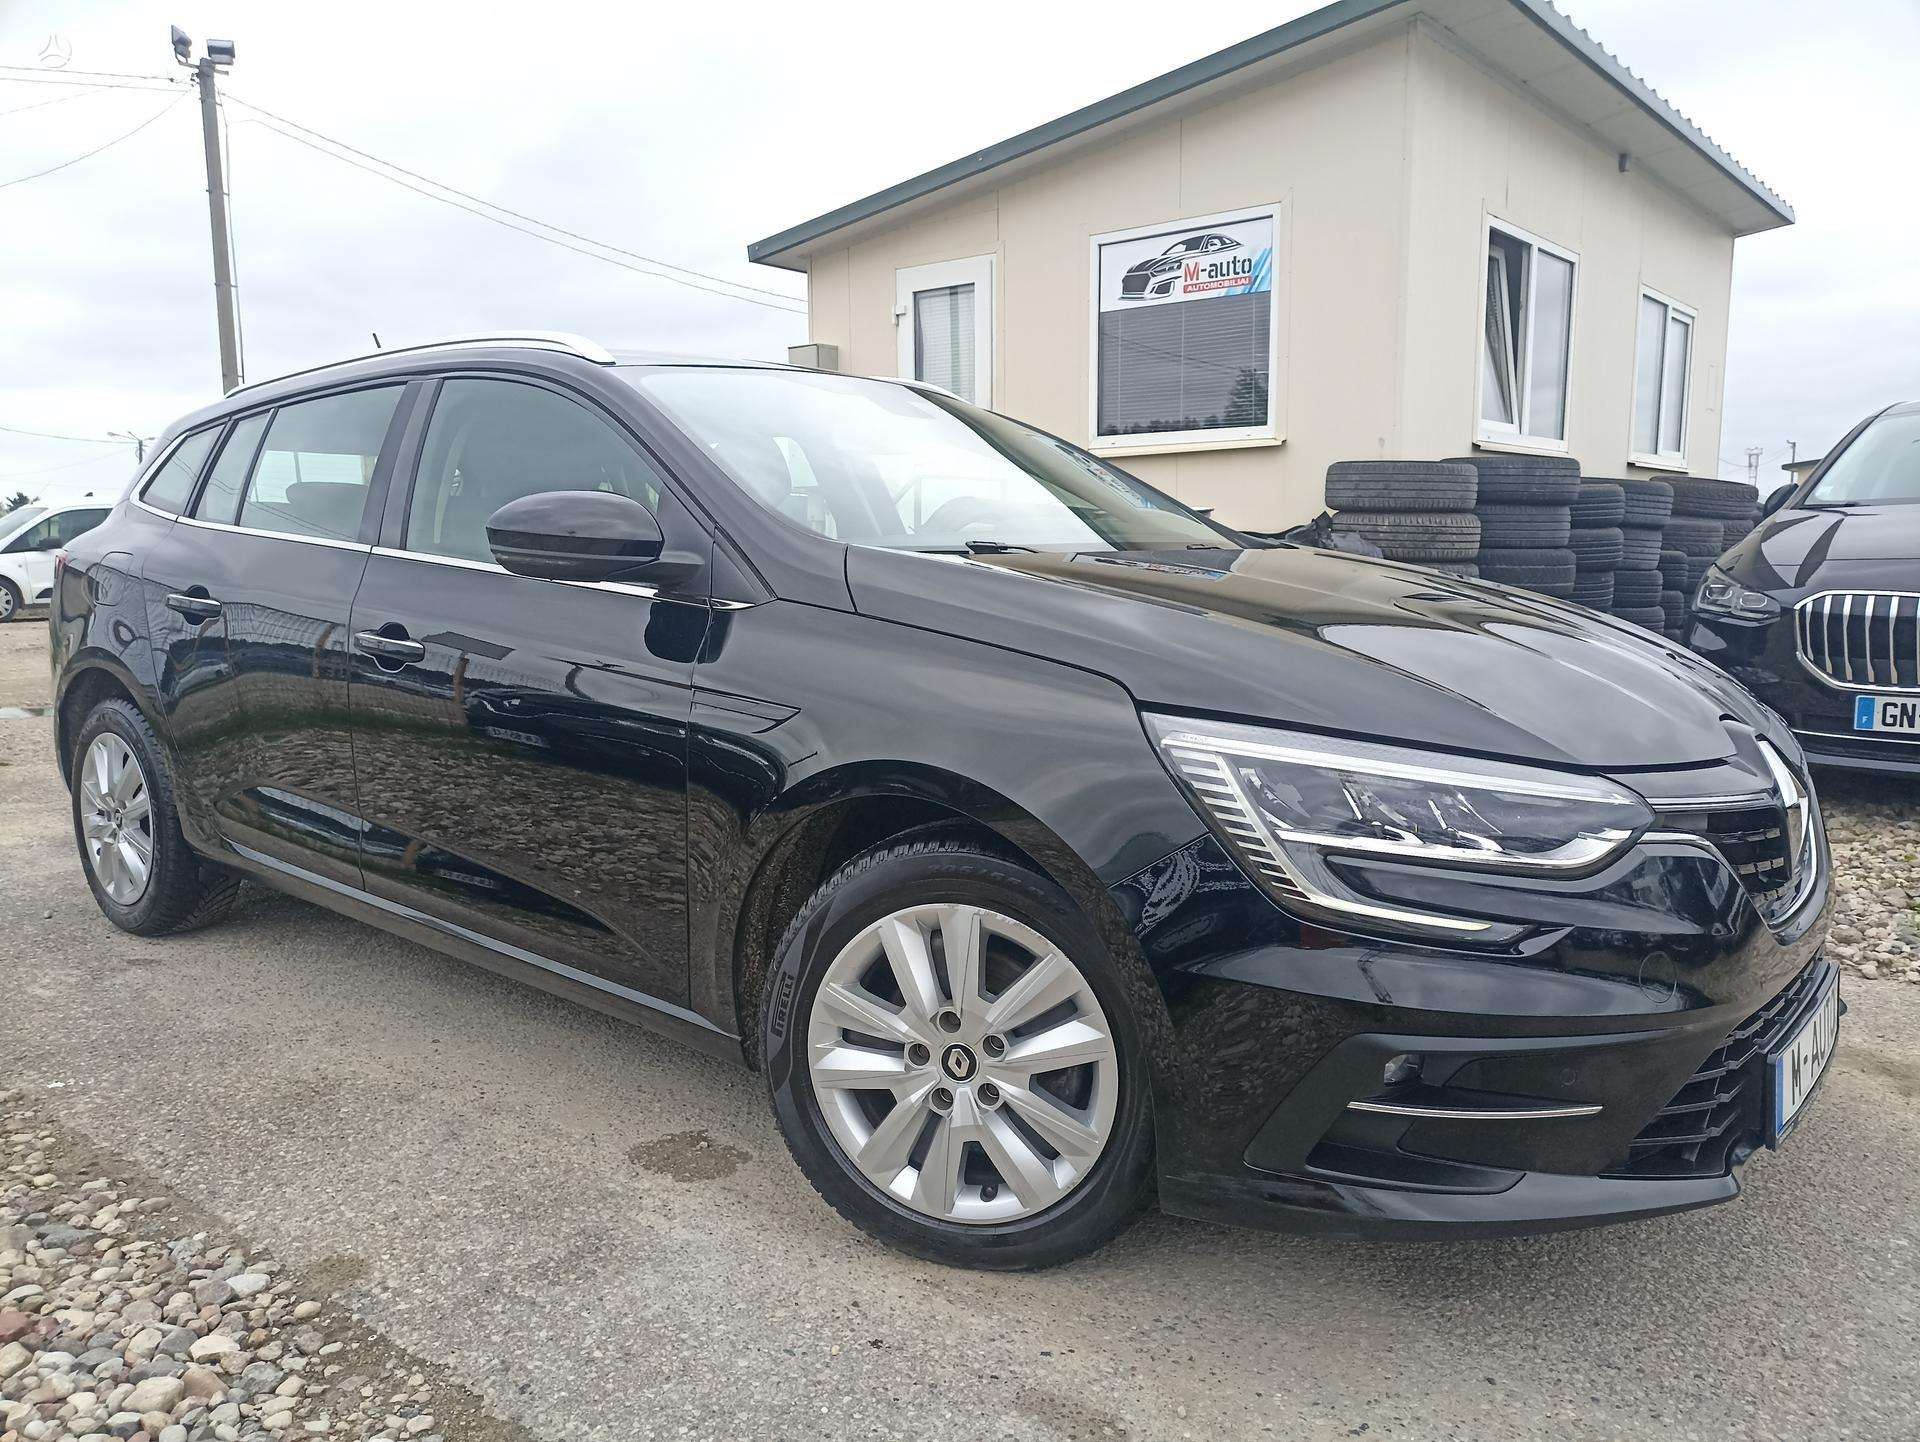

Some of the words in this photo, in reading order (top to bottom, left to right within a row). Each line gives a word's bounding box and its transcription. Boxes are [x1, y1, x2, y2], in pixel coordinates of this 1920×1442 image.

[1184, 256, 1253, 283] M-auto
[1187, 278, 1249, 292] AUTOMOBILIAI
[1862, 715, 1869, 724] F
[1881, 701, 1920, 729] GN
[770, 971, 795, 1038] PIRELLI
